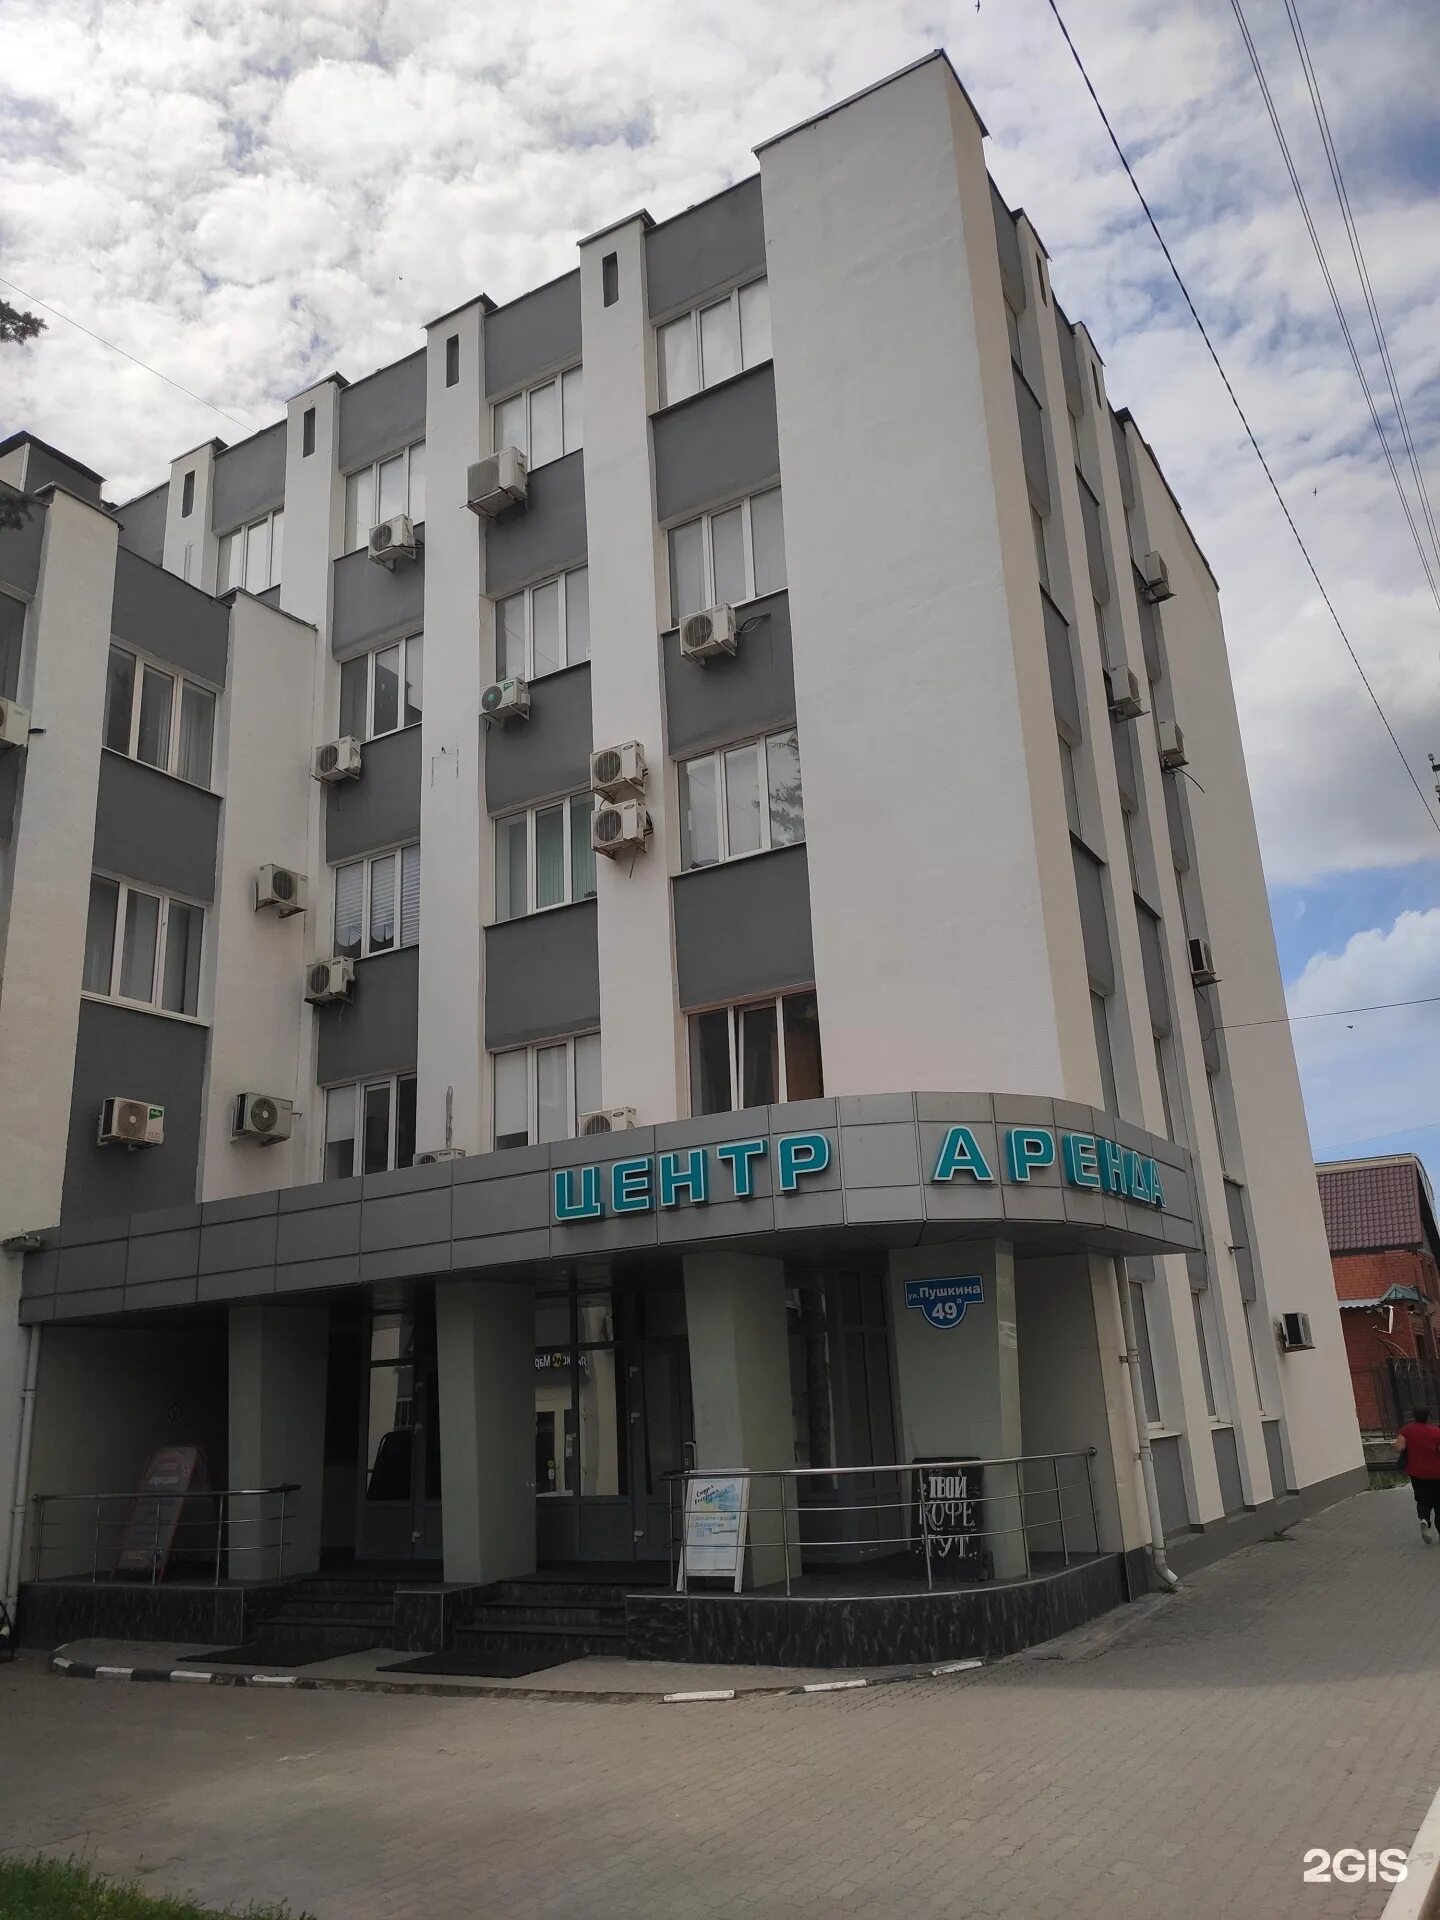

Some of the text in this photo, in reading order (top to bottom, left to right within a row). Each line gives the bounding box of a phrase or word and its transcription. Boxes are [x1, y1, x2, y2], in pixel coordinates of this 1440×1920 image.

[554, 1125, 1168, 1221] ЦЕНТР АРЕНДА
[928, 1468, 967, 1498] ТВОЙ
[919, 1499, 976, 1531] КОФЕ
